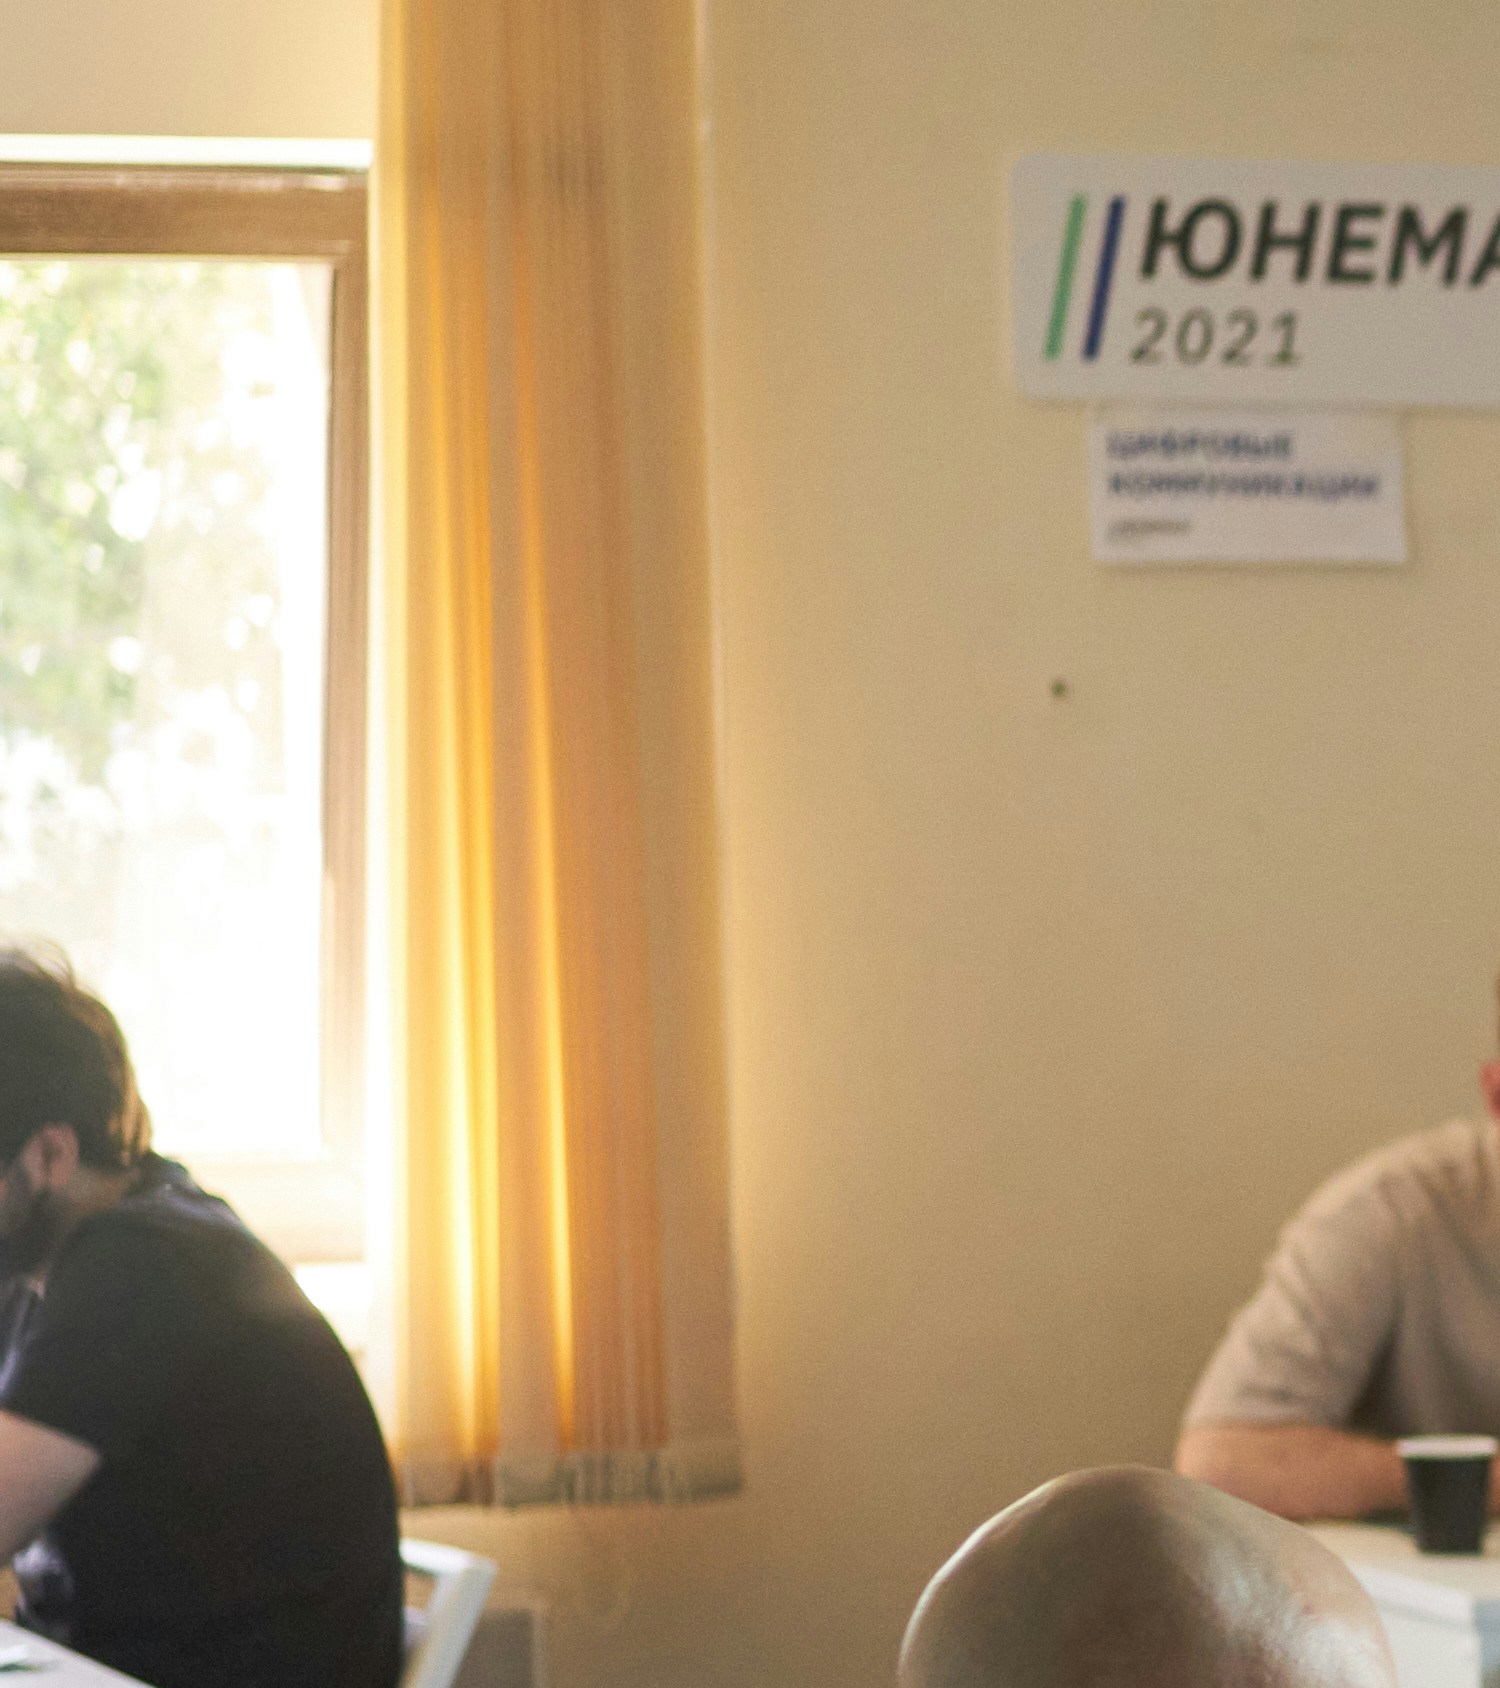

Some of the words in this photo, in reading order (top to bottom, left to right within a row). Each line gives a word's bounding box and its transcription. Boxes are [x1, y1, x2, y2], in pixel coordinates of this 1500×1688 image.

[1130, 307, 1304, 367] 2021
[1105, 428, 1292, 462] ЦИФРОВЫЕ
[1108, 469, 1382, 504] КОММУНИКАЦИИ
